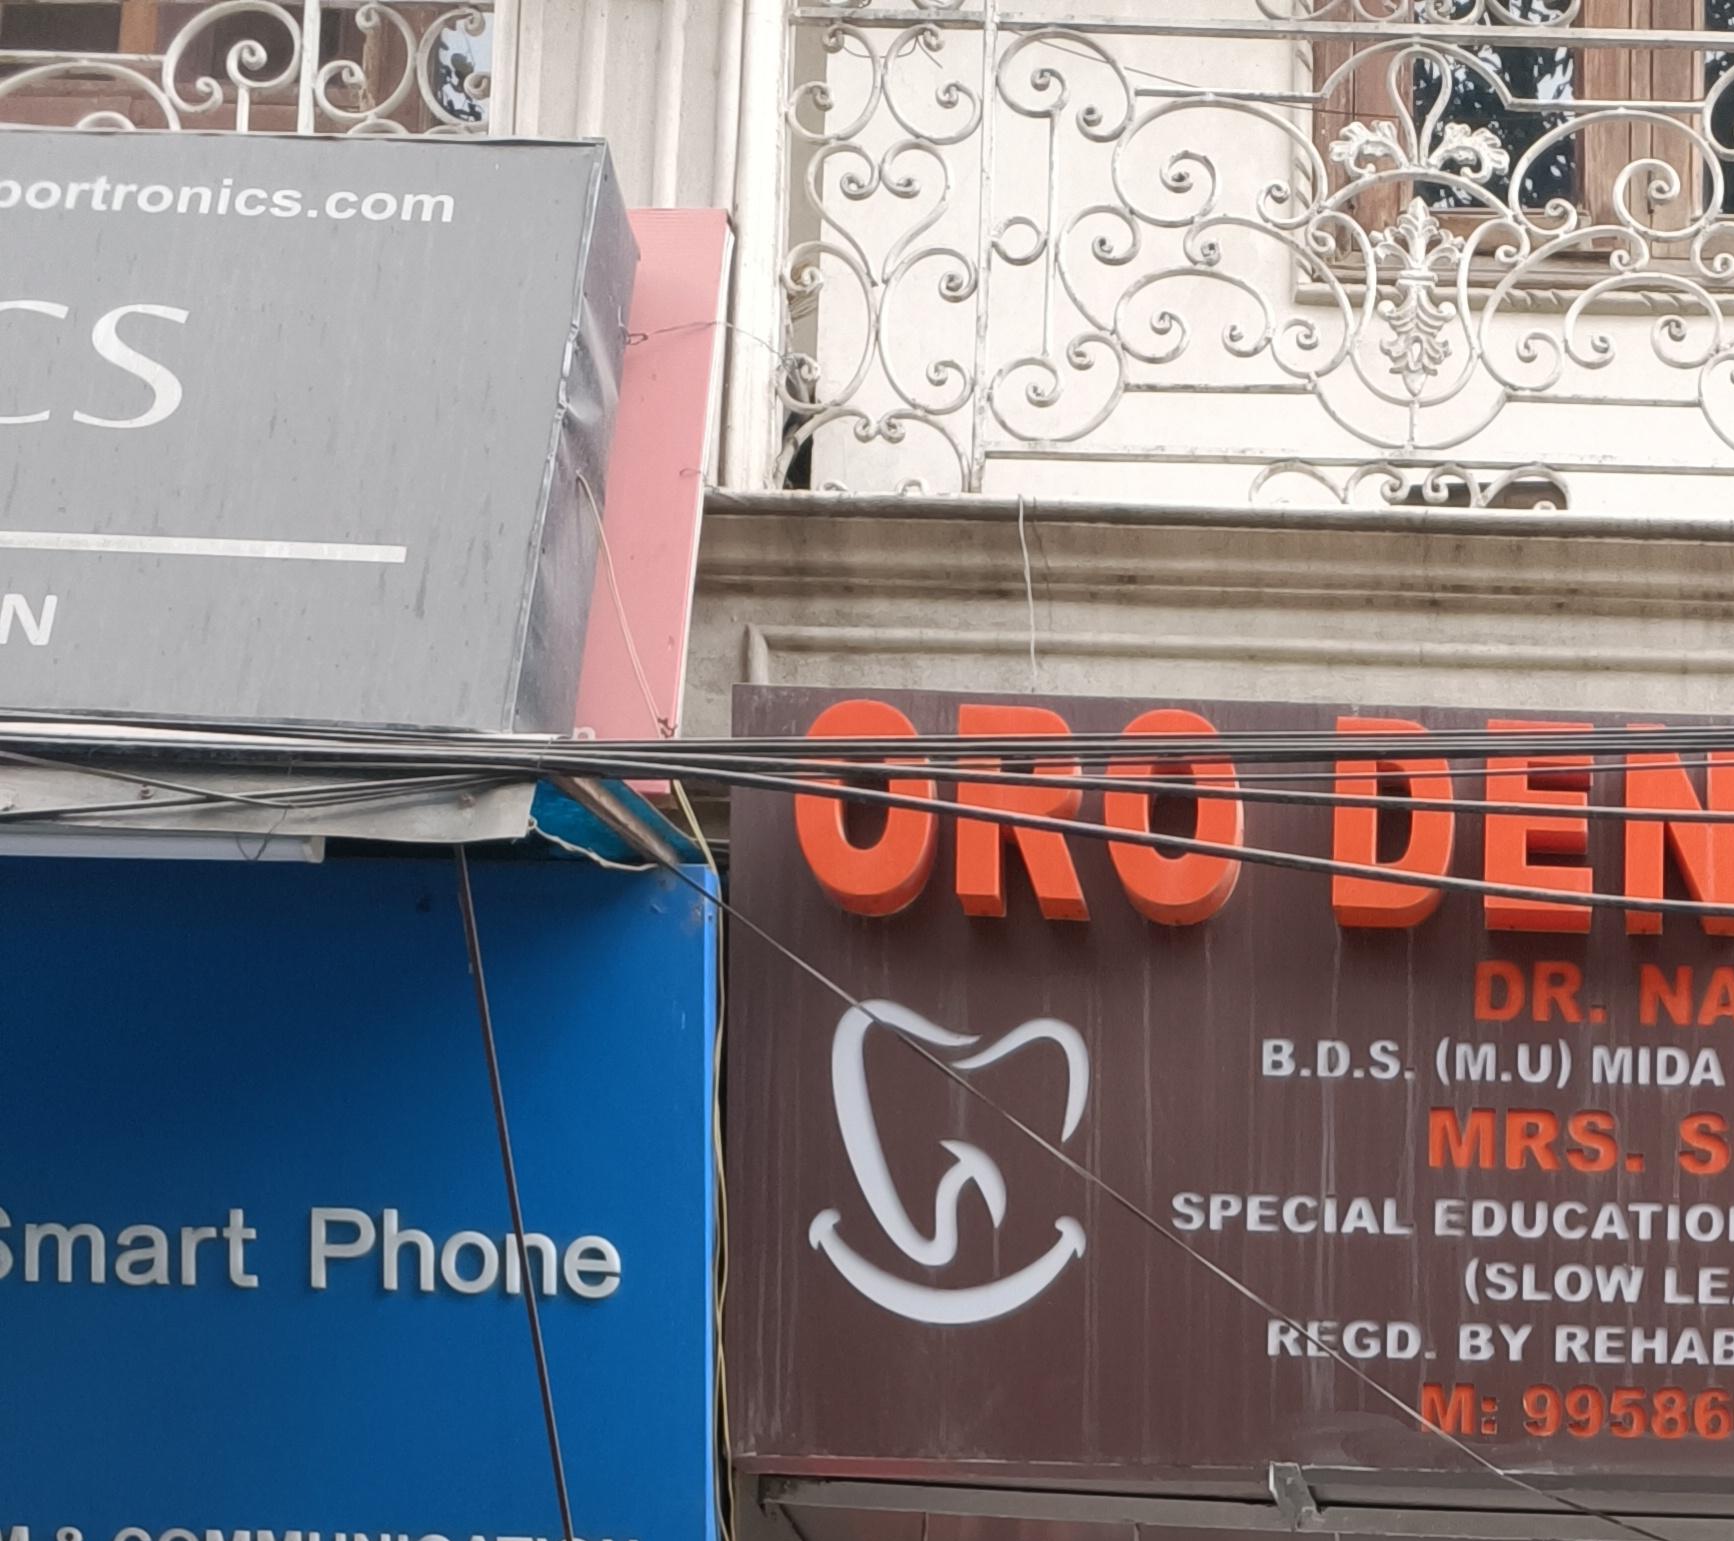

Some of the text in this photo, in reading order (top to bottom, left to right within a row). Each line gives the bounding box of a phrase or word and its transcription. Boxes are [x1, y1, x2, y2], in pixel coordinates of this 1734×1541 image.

[794, 697, 1244, 928] ORO
[1474, 961, 1606, 1028] DR.
[1435, 1040, 1573, 1089] (M.U)
[1590, 1046, 1724, 1089] MIDA
[1429, 1106, 1645, 1172] MRS.
[1170, 1192, 1414, 1238] SPECIAL
[0, 1205, 622, 1299] mart Phone
[1464, 1258, 1643, 1305] (SLOW
[1267, 1319, 1437, 1360] REGD.
[1458, 1323, 1529, 1363] BY
